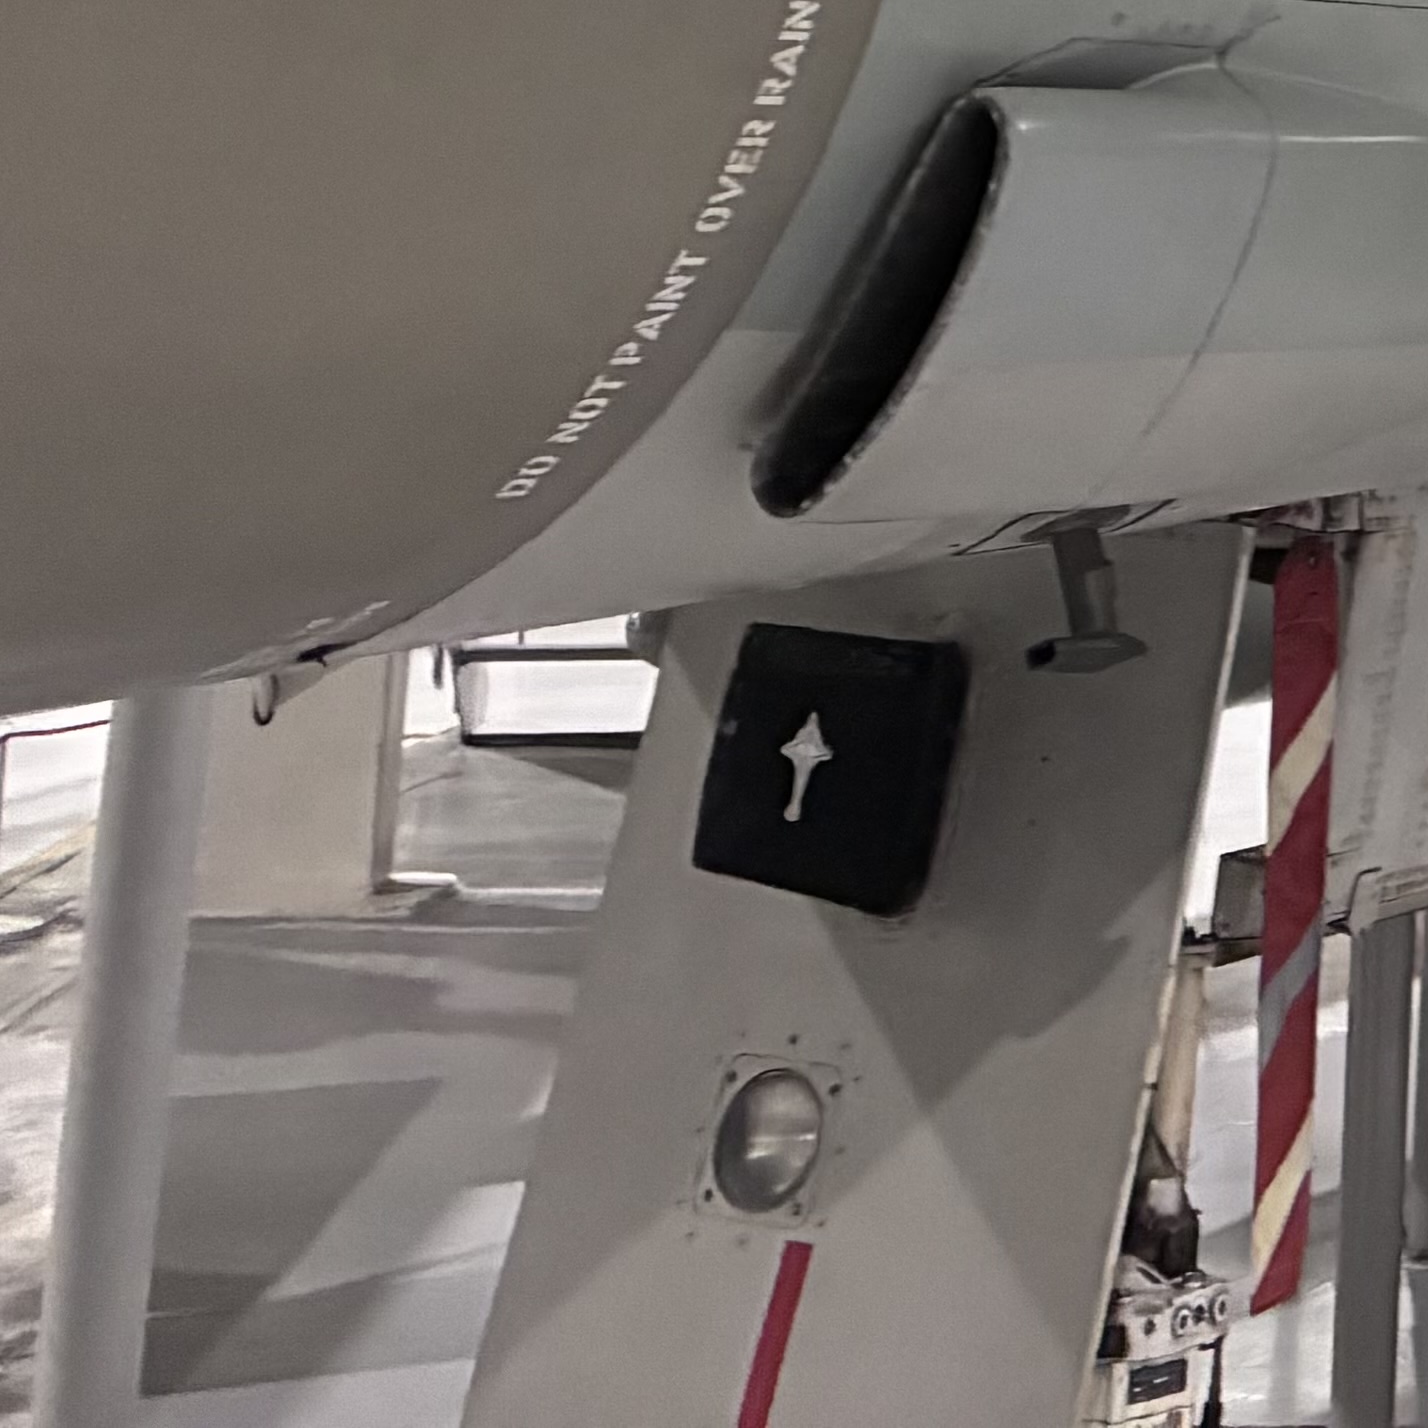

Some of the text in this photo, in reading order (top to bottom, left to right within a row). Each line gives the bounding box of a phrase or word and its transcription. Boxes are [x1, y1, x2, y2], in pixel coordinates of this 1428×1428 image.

[496, 455, 561, 499] DO
[546, 374, 627, 444] NOT
[609, 248, 709, 366] PAINT
[694, 119, 777, 232] OVER
[752, 0, 821, 107] RAIN
